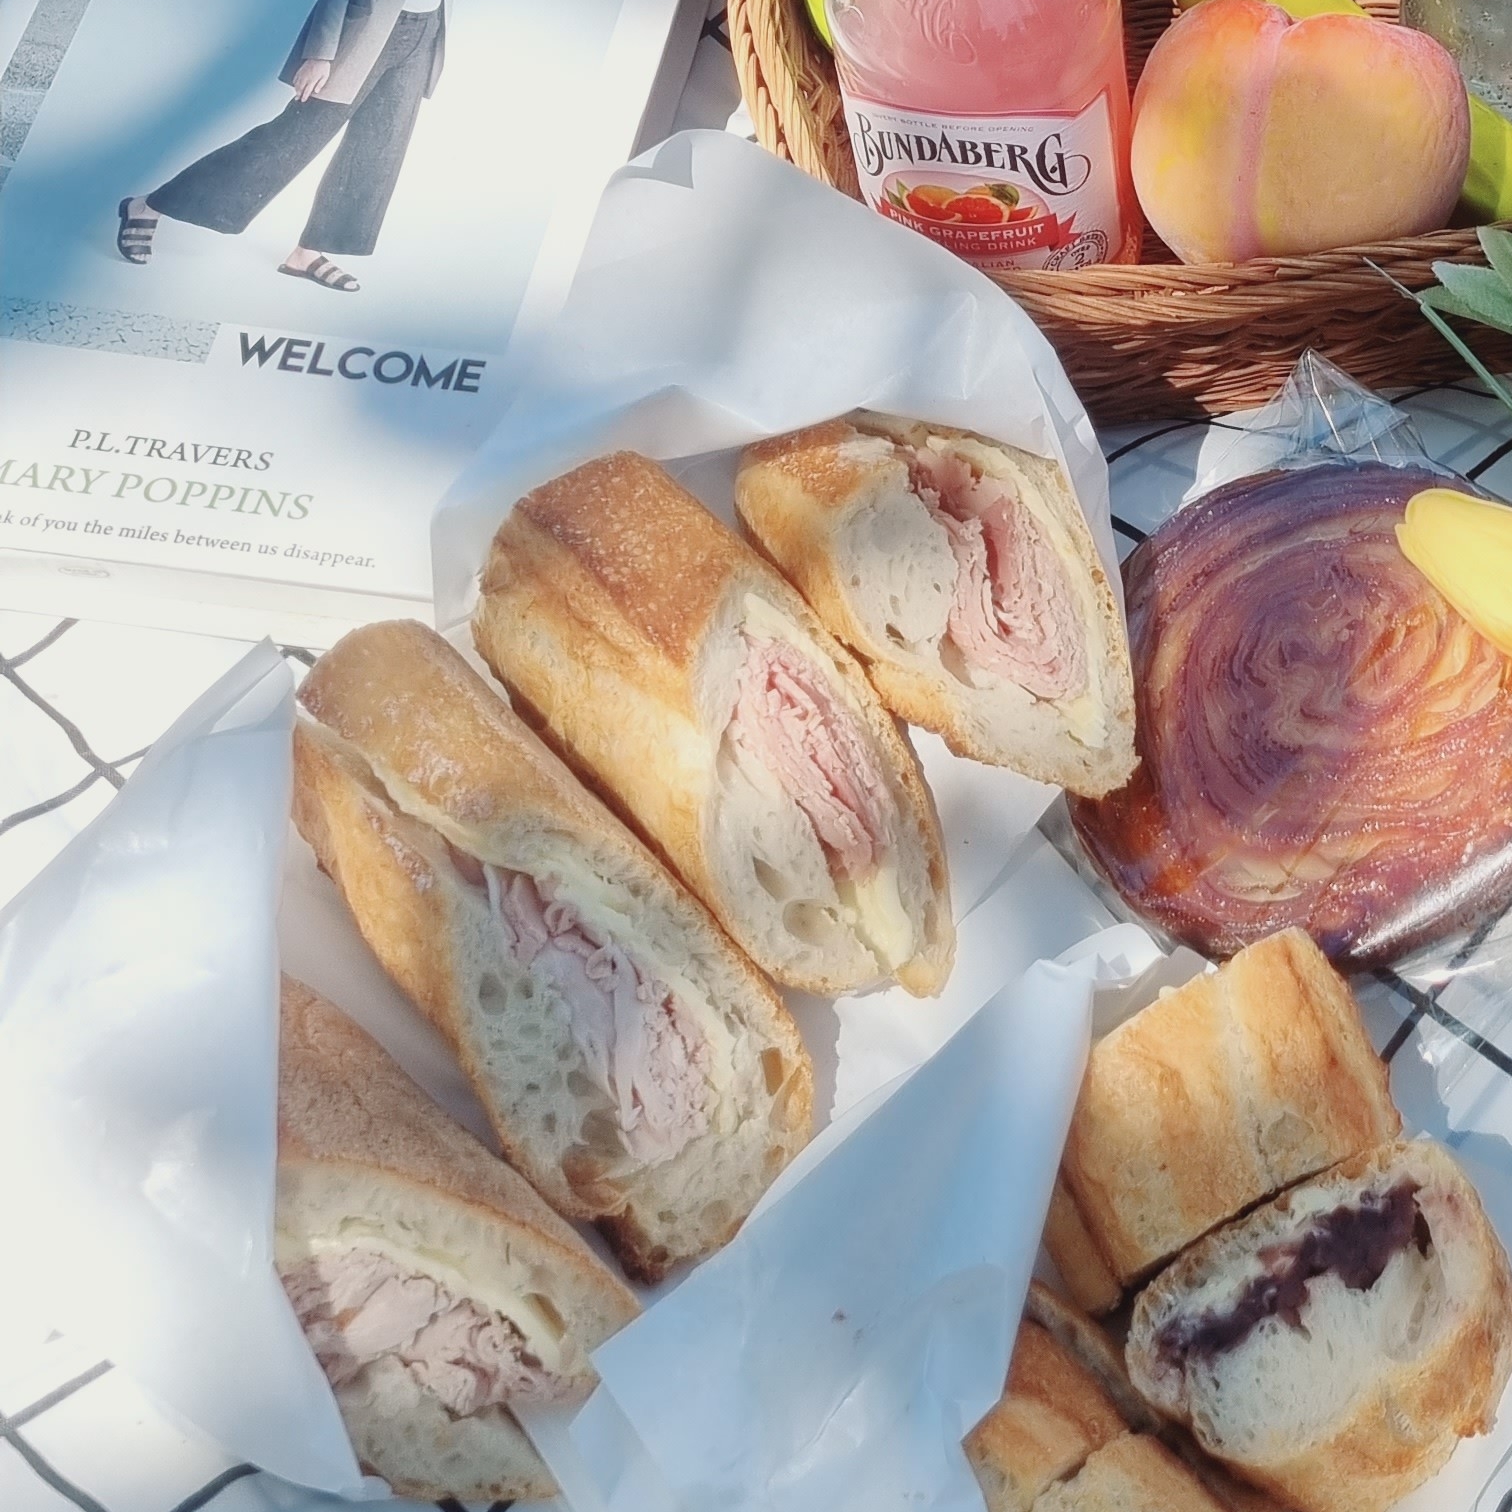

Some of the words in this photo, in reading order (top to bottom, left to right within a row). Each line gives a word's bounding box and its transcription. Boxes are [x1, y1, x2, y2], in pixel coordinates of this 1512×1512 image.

[900, 118, 938, 129] BOTTLE
[941, 124, 984, 133] BEFORE
[853, 111, 1092, 196] BUNDABERG
[889, 208, 924, 233] PINK
[929, 223, 1045, 241] GRAPEFRUIT
[987, 237, 1037, 251] DRINK
[238, 331, 487, 393] WELCOME
[111, 471, 315, 521] POPPINS
[19, 512, 45, 528] of
[42, 516, 79, 533] you
[83, 519, 114, 536] the
[118, 524, 169, 543] miles
[173, 529, 253, 553] between
[257, 541, 279, 556] us
[283, 542, 377, 569] disappear.
